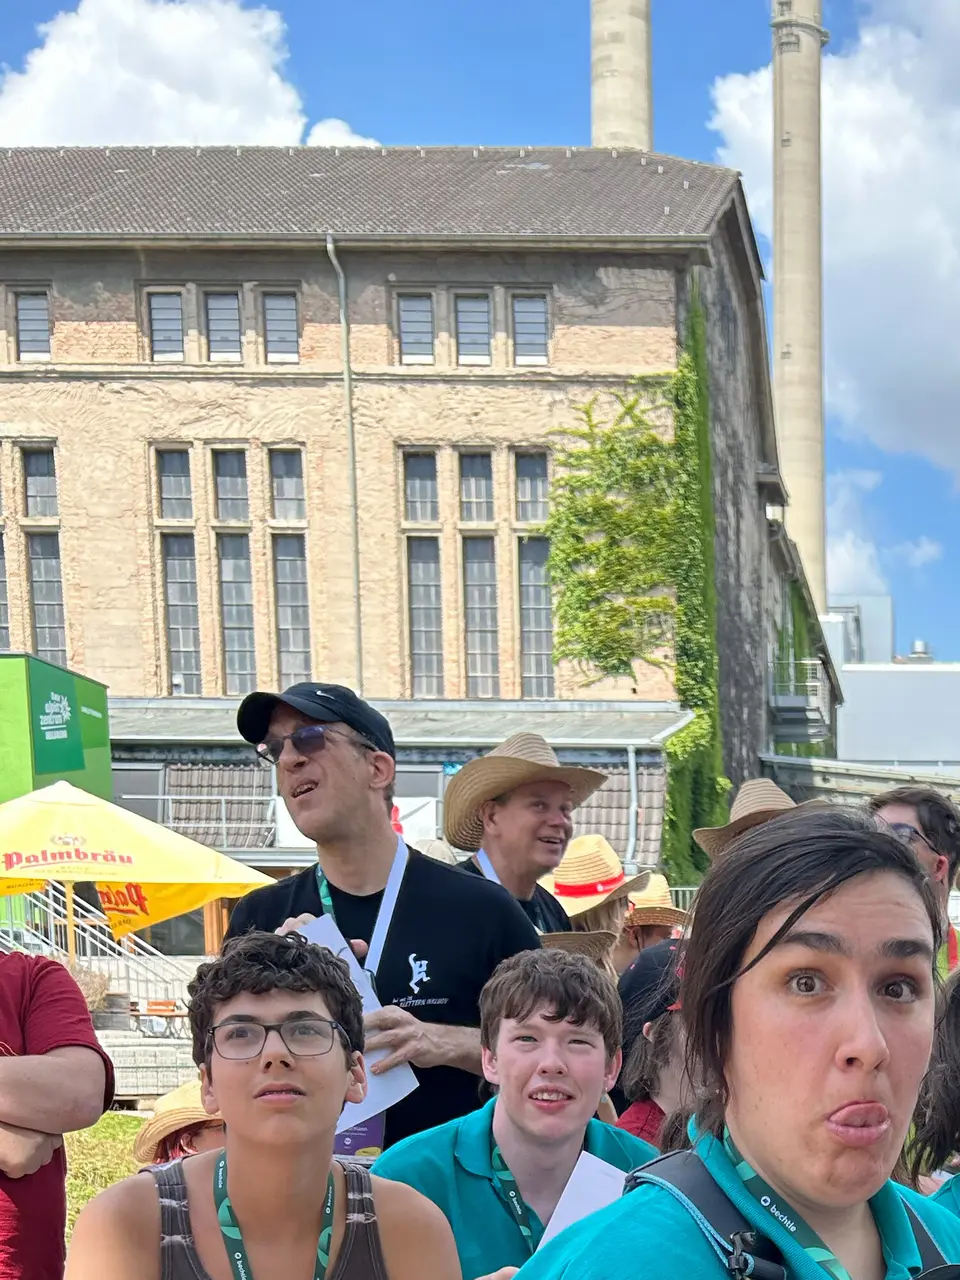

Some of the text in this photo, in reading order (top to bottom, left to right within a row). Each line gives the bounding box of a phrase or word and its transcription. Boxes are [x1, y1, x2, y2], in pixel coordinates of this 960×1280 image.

[3, 848, 133, 871] Palmbräu
[770, 1204, 797, 1233] bechtle
[236, 1260, 247, 1280] bechtle
